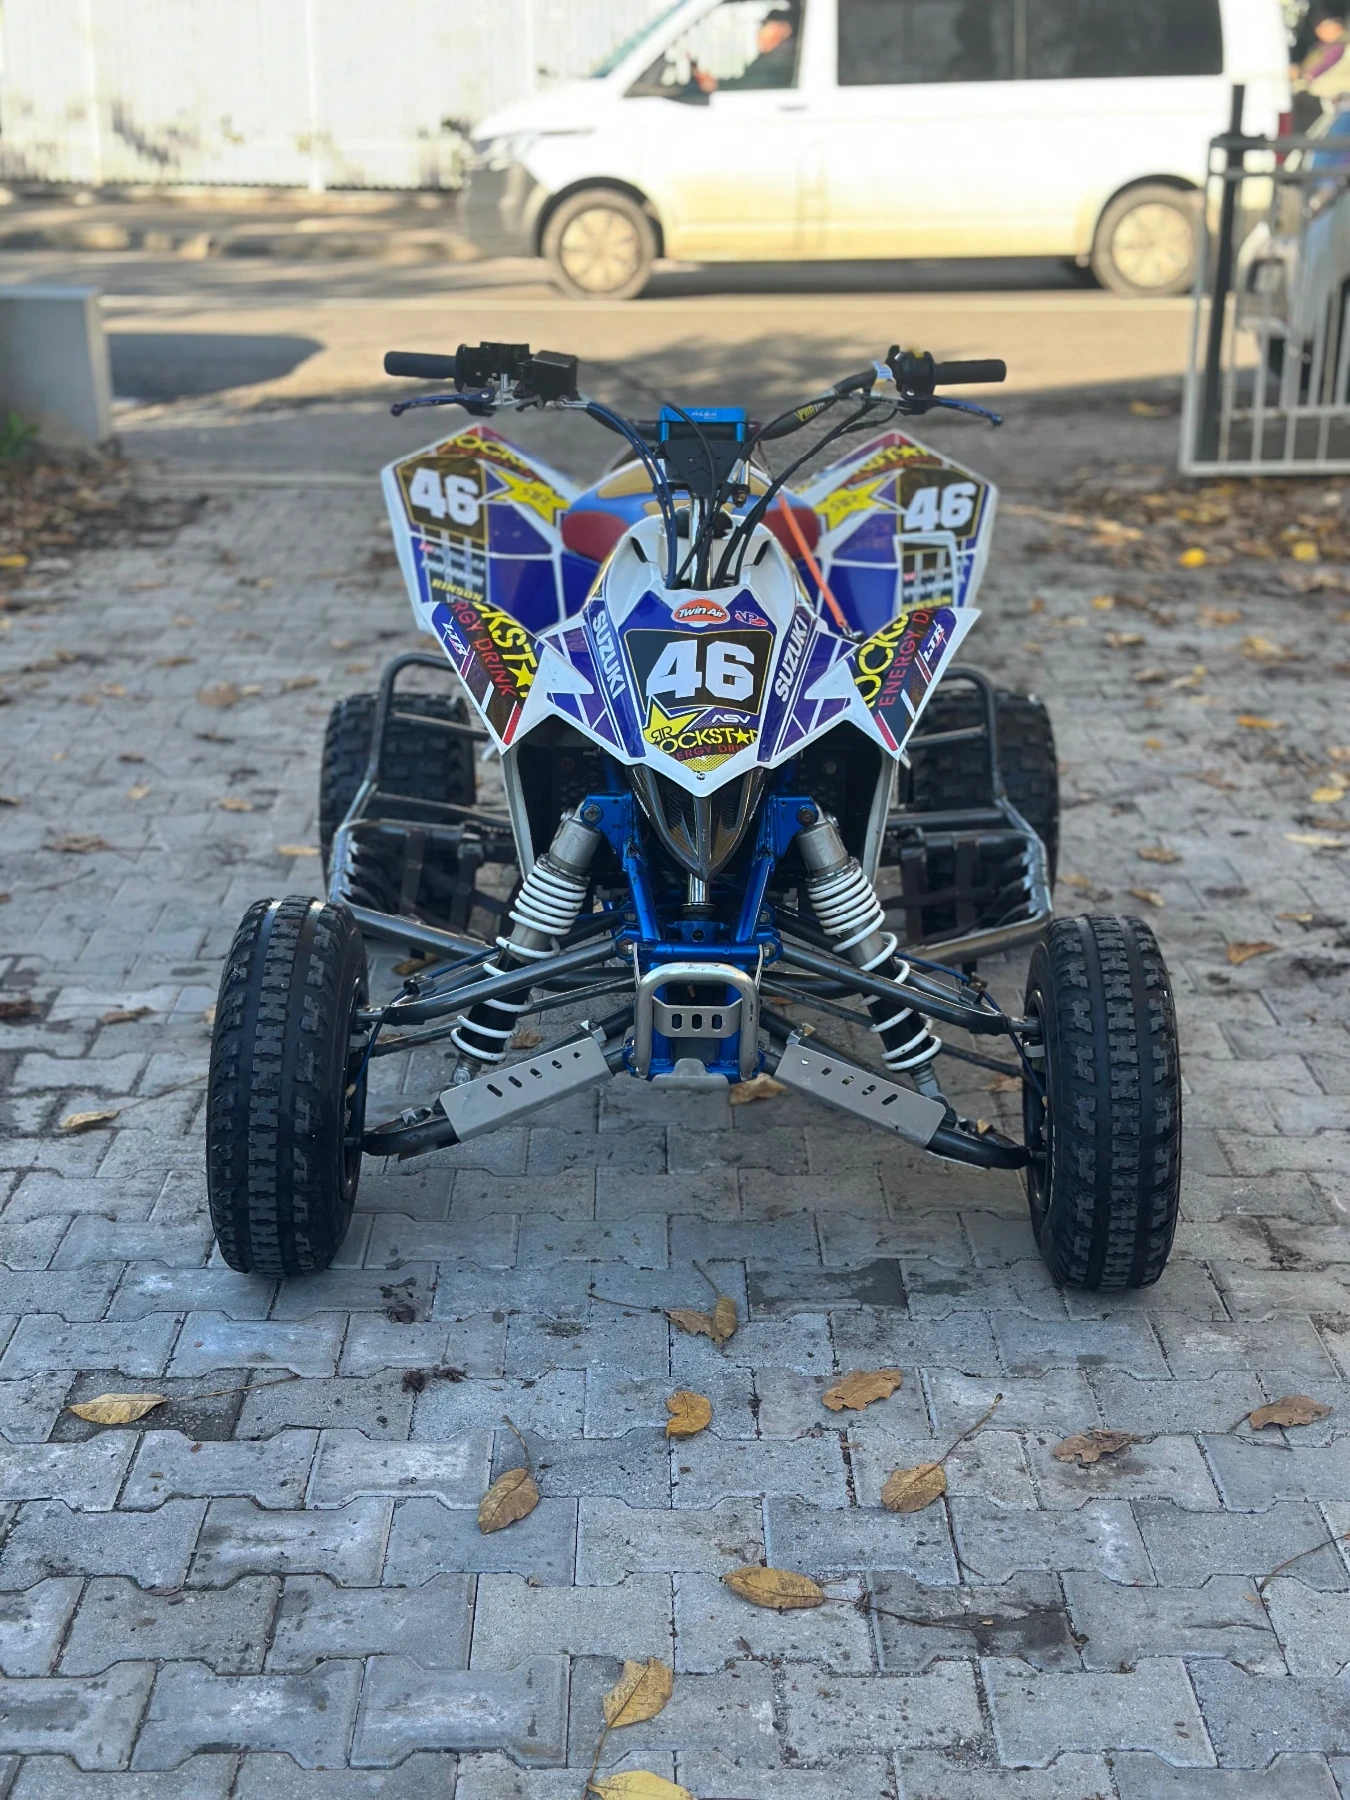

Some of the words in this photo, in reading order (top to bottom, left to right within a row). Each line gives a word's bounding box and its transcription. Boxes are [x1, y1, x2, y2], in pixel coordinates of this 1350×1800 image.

[409, 467, 480, 527] 46
[904, 481, 977, 531] 46
[679, 605, 706, 618] Twin
[707, 607, 726, 619] Air
[593, 610, 626, 700] SUZUKI
[645, 639, 755, 701] 46
[775, 614, 808, 702] SUZUKI
[878, 630, 923, 707] ENERGY
[711, 714, 751, 724] ASV
